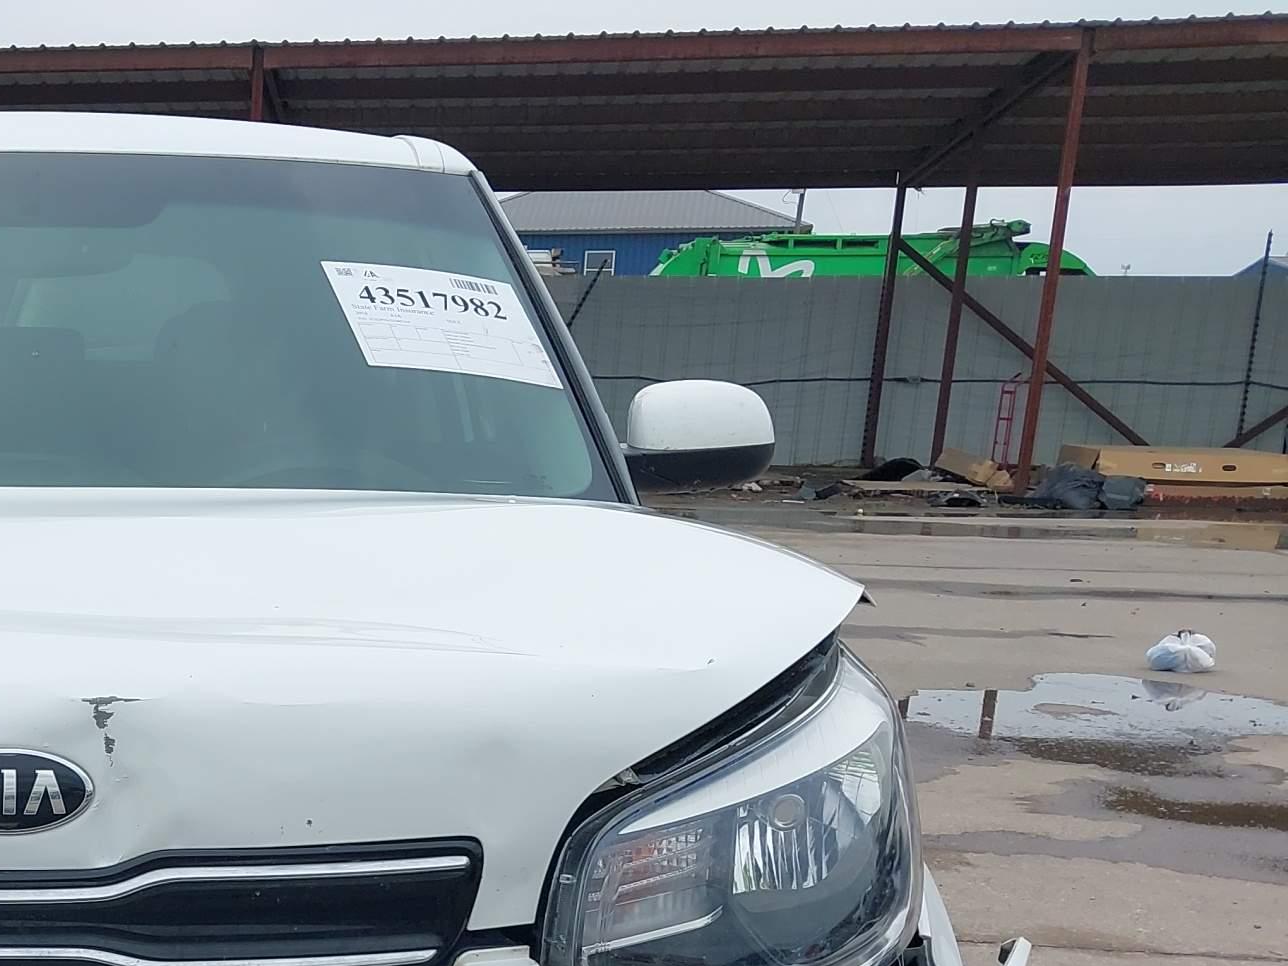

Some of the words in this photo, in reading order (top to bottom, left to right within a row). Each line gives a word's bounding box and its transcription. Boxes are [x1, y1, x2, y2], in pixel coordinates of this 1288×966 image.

[351, 303, 371, 311] State
[396, 306, 435, 316] Insurance
[358, 285, 508, 320] 43517982
